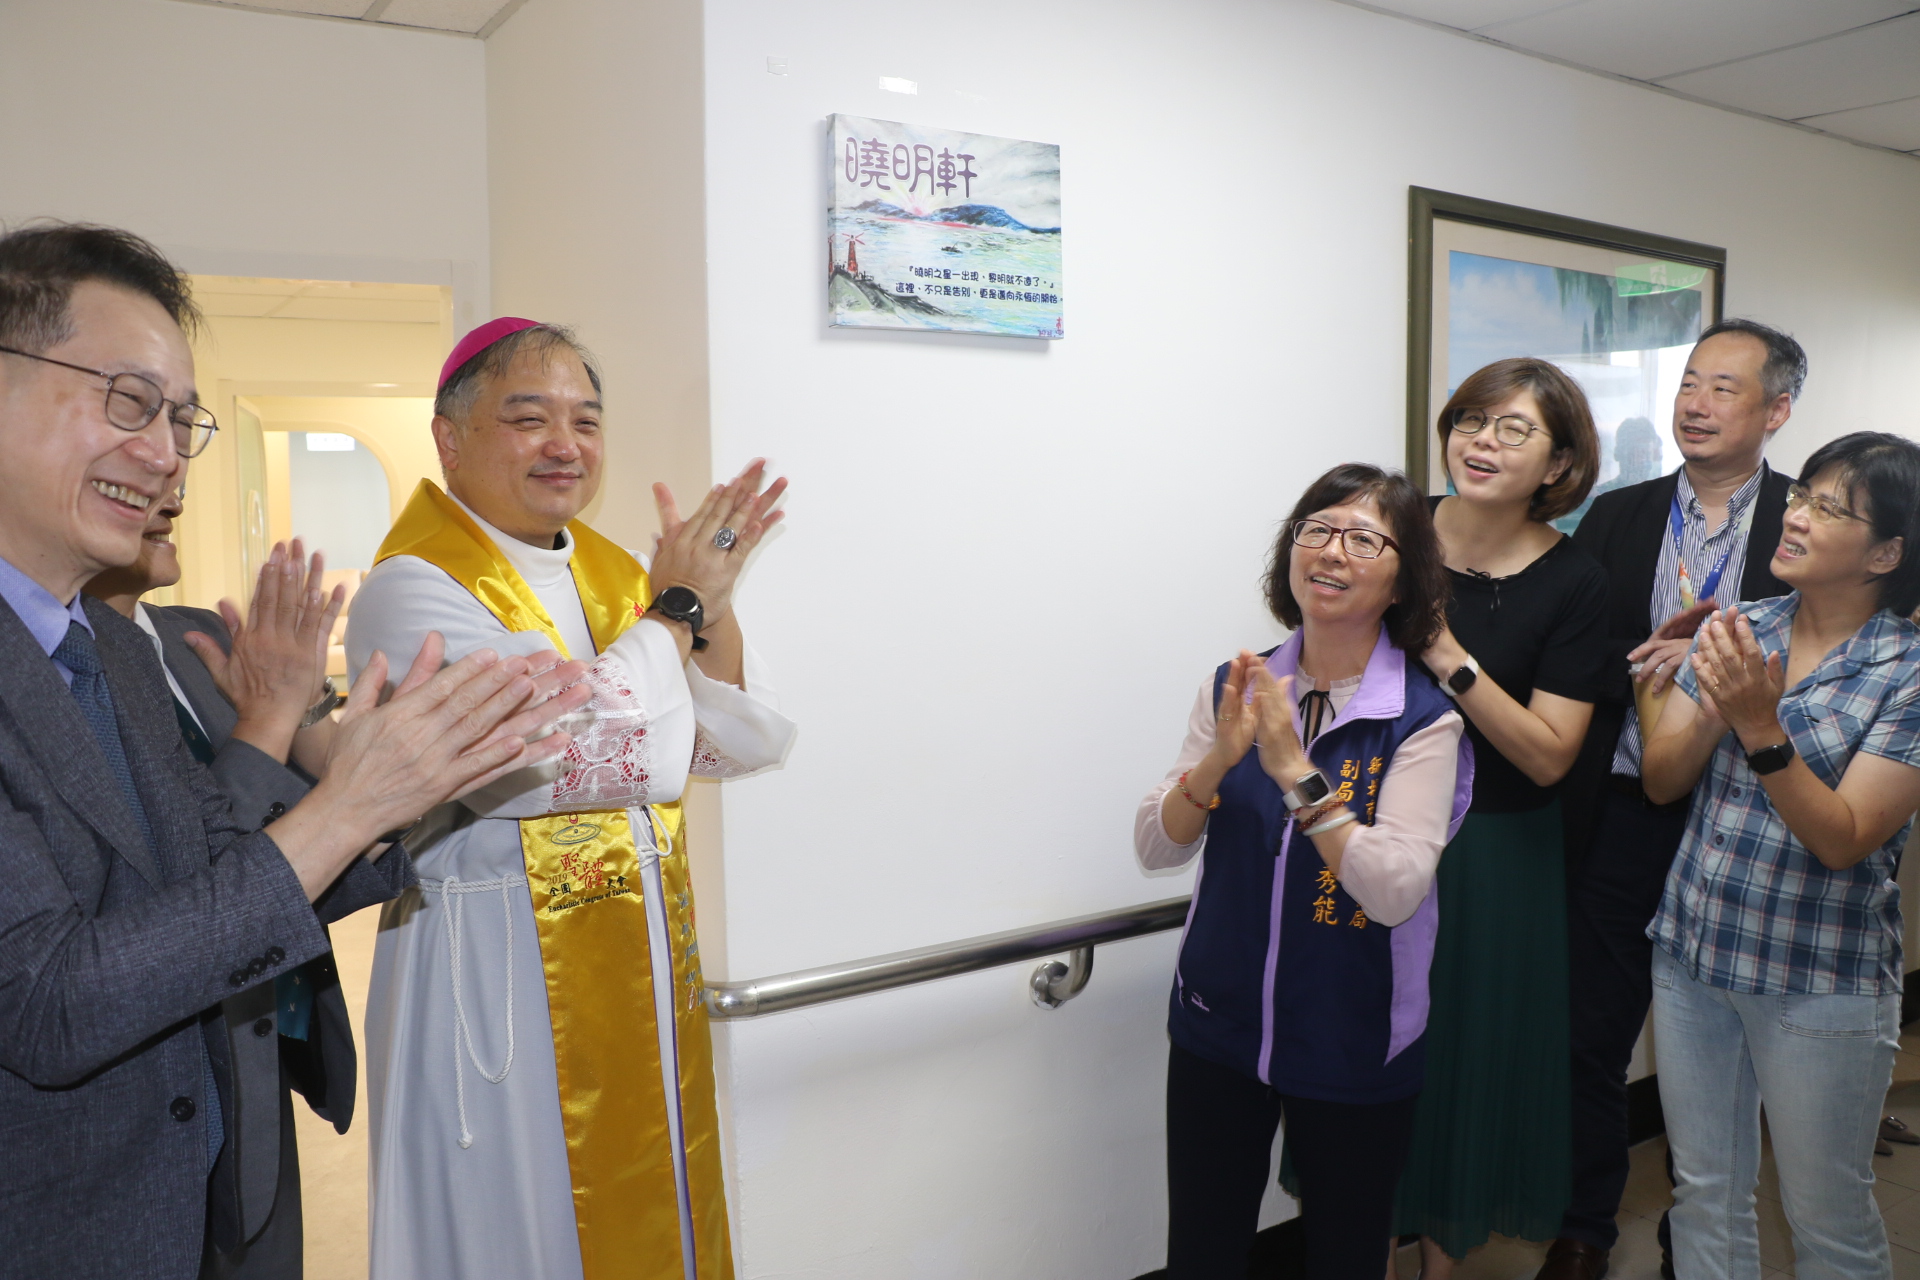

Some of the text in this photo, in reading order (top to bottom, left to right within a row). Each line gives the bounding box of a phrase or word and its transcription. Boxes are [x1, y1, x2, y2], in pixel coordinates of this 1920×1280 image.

[845, 137, 978, 198] 曉明軒
[549, 882, 572, 897] 全國
[1312, 866, 1339, 926] 秀能
